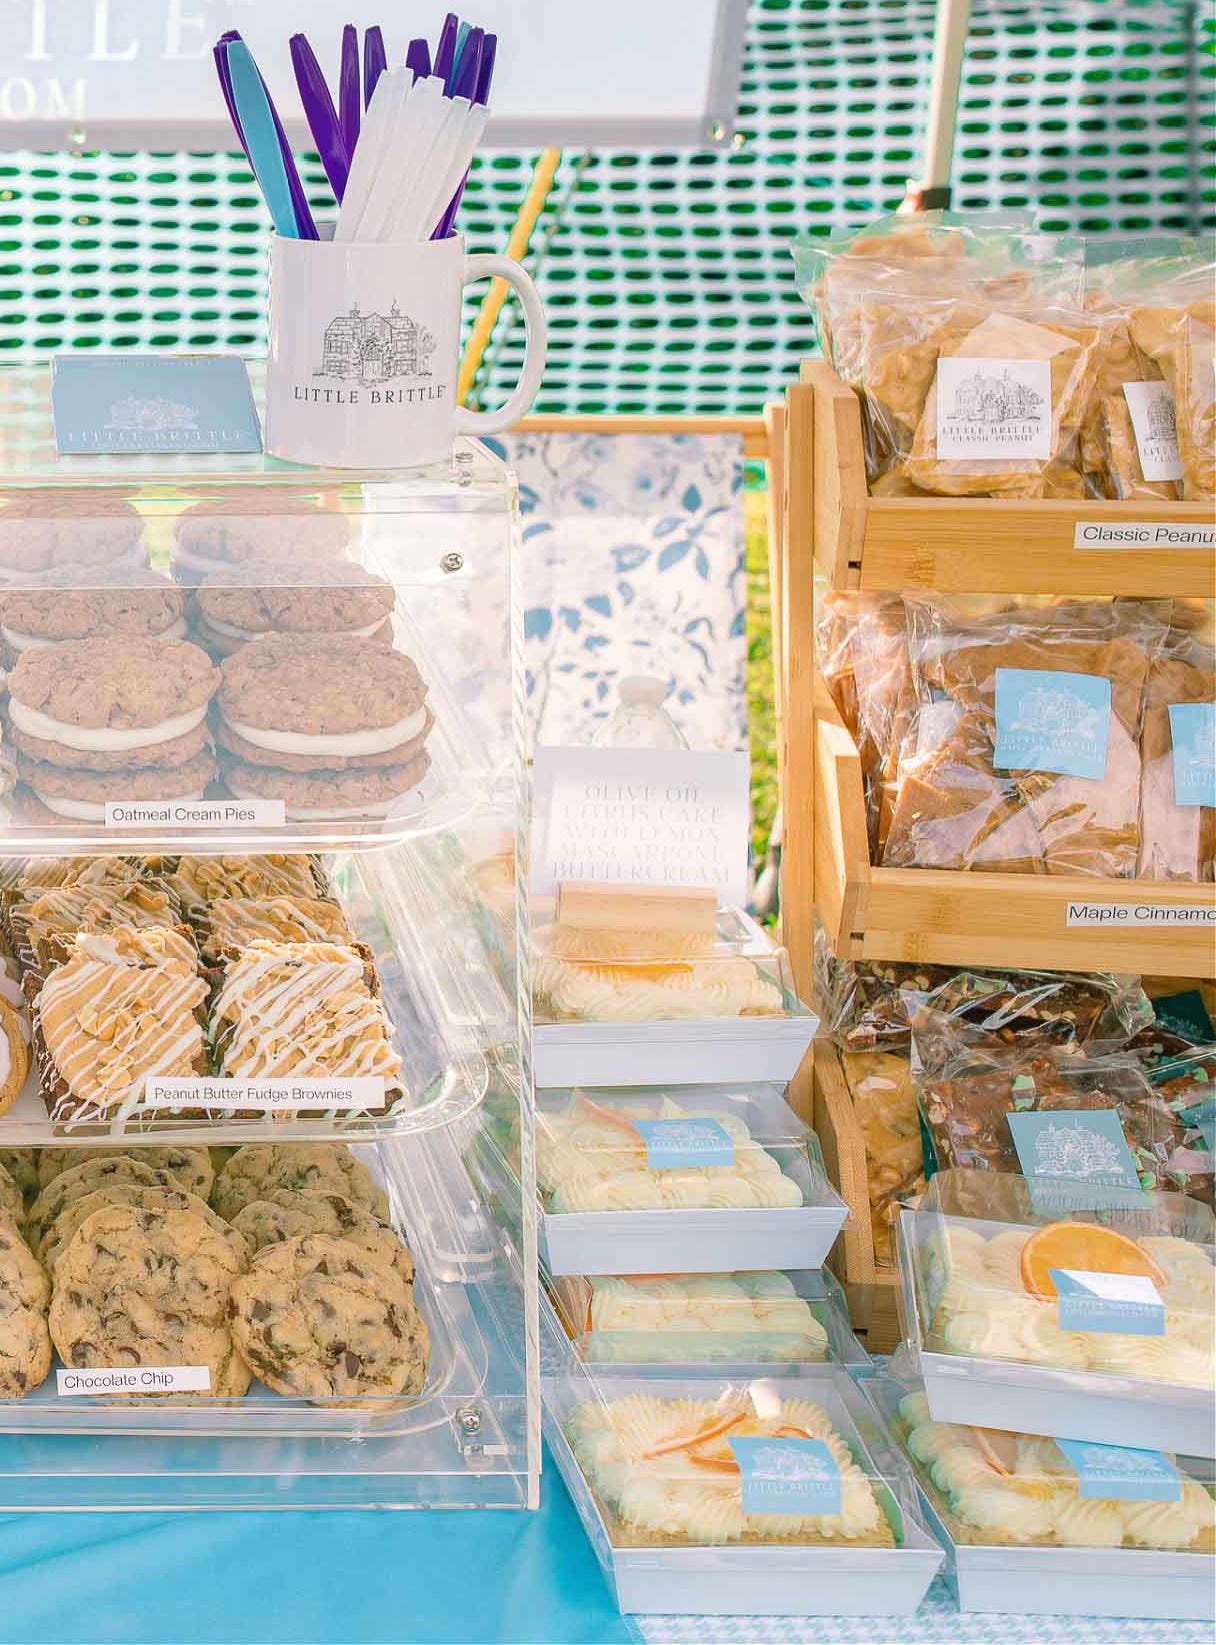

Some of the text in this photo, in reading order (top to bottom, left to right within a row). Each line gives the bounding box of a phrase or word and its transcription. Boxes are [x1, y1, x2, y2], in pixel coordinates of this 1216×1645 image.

[294, 384, 447, 404] LITTLE BRITTLE
[943, 424, 991, 435] LITTLE
[1083, 526, 1216, 543] Classic Peanu
[584, 782, 705, 803] OLIVE OIL
[112, 807, 256, 821] Oatmeal Cream Pies
[1068, 905, 1129, 922] Maple
[154, 1087, 353, 1103] Peanut Butter Fudge Brownies
[65, 1371, 174, 1390] Chocolate Chip
